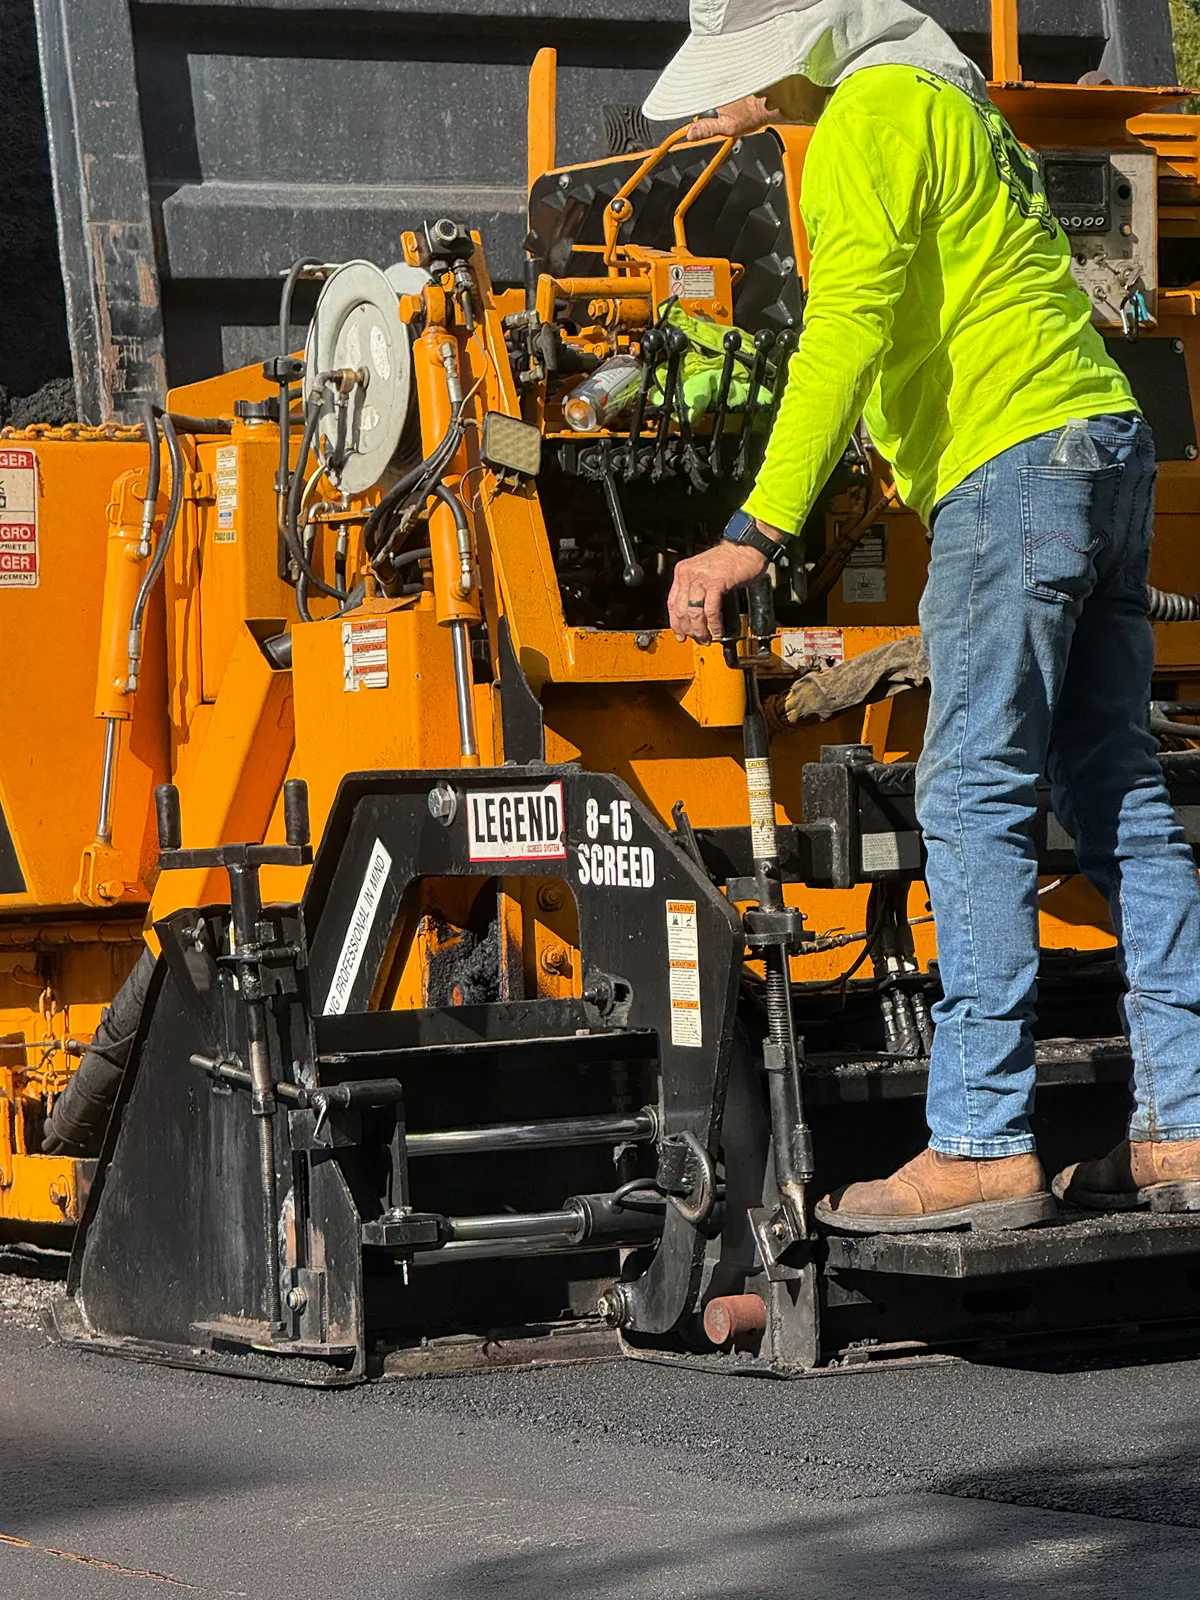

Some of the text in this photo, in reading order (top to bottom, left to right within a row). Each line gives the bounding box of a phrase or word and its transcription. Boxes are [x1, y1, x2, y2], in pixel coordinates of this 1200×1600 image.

[1, 555, 30, 570] GER
[472, 795, 559, 843] LEGEND
[585, 798, 633, 842] 8-15
[526, 843, 543, 853] SCREED
[543, 843, 560, 852] SYSTEM
[577, 843, 655, 888] SCREED
[328, 855, 386, 1016] NG PROFESSIONAL IN MIND
